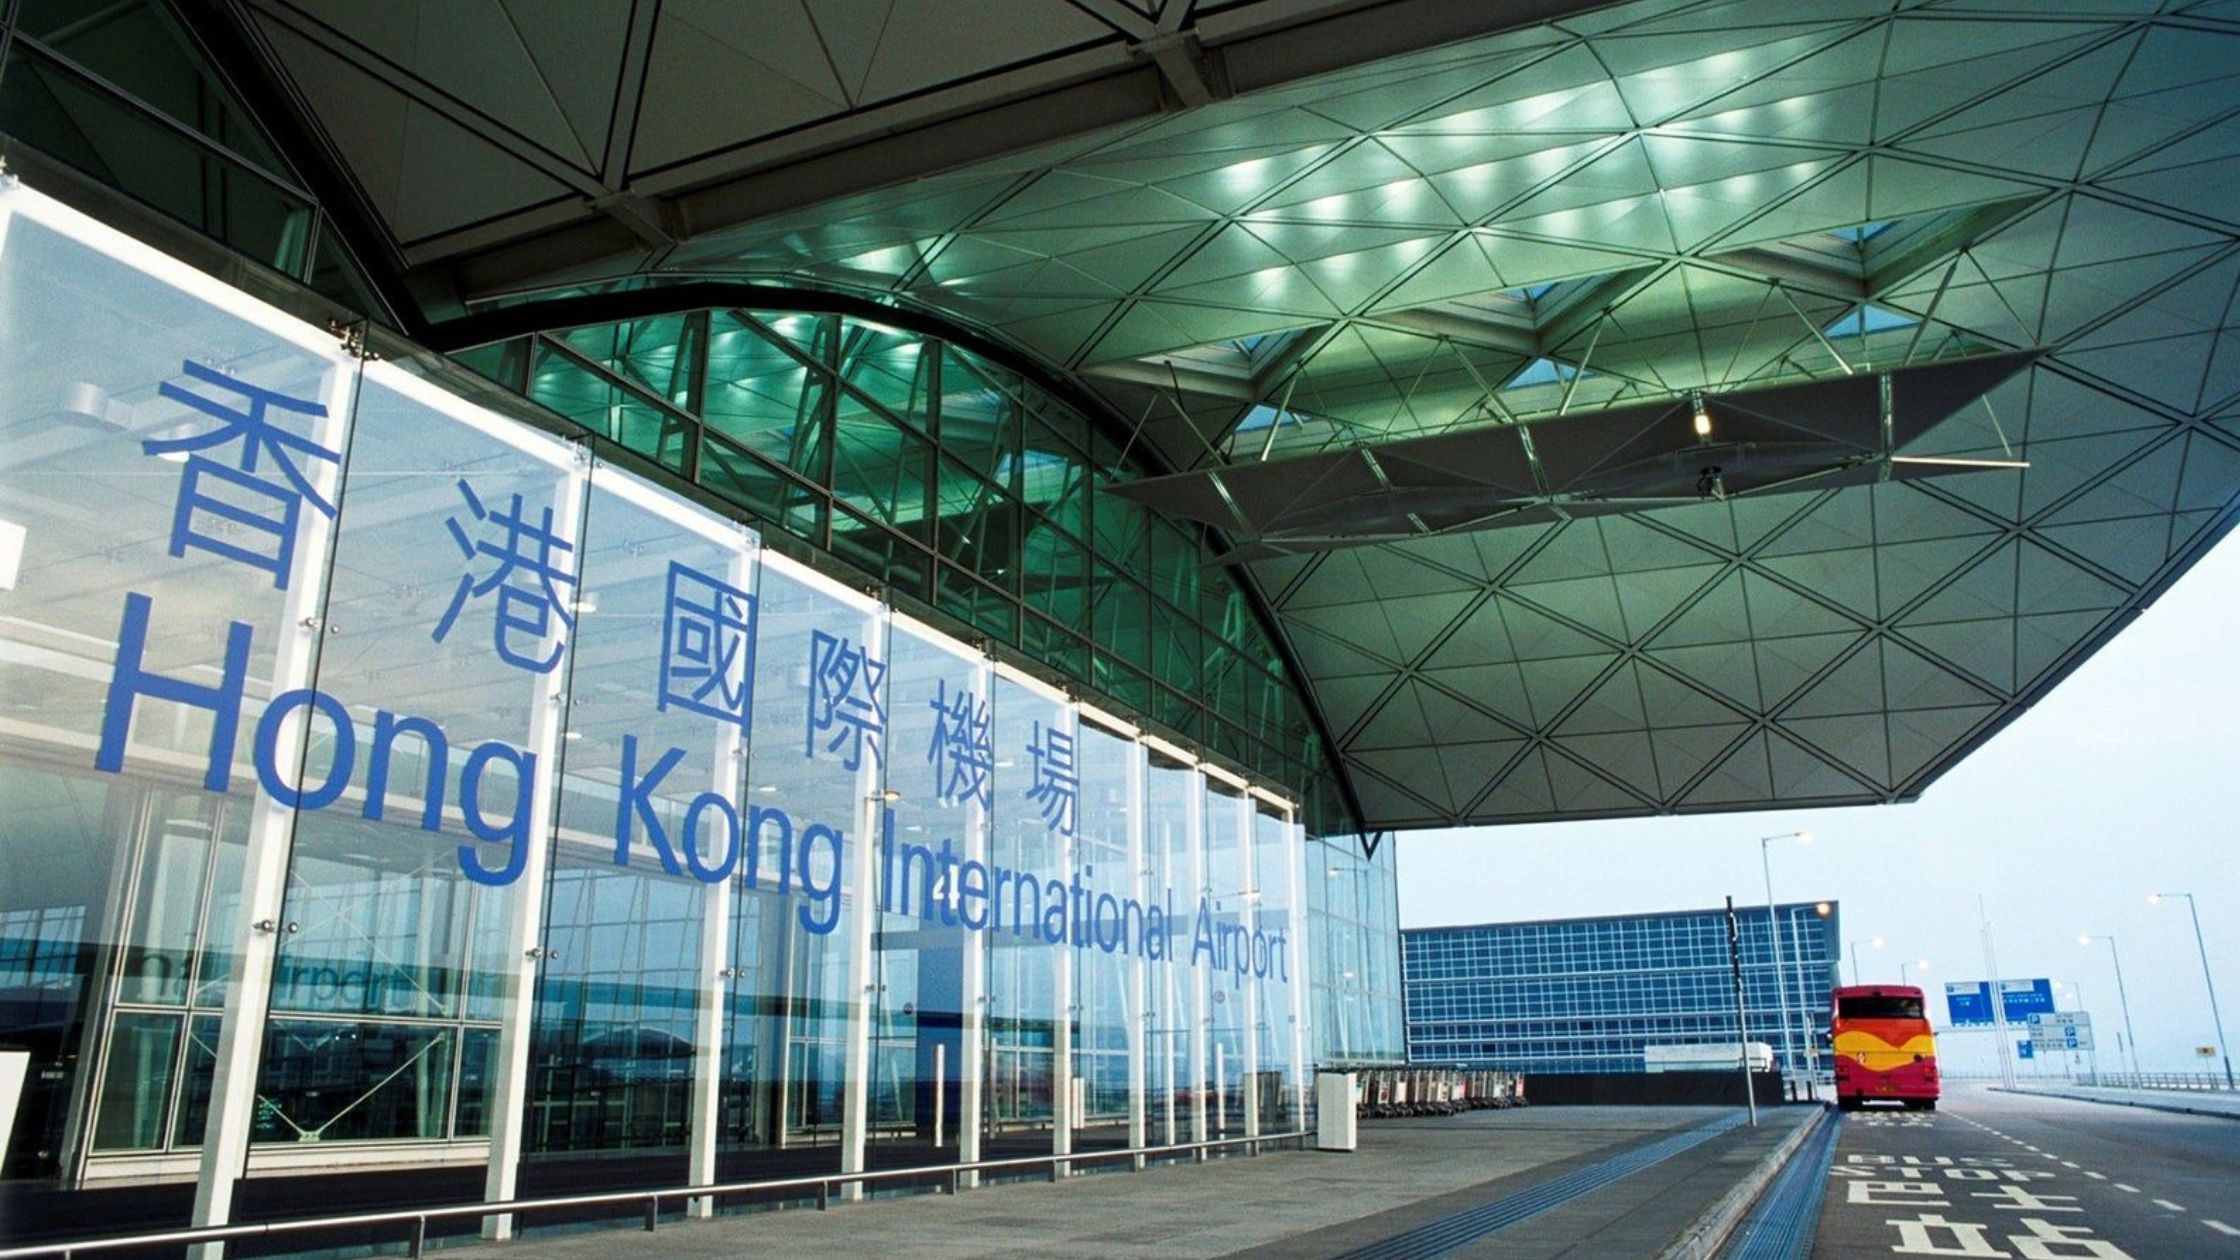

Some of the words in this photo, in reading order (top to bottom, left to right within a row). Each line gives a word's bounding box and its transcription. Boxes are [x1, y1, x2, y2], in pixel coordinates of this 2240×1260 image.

[142, 359, 1080, 837] 香港國際機場
[94, 591, 537, 887] Hong
[613, 734, 844, 935] Kong
[882, 807, 1173, 963] International
[1191, 896, 1288, 990] Airport
[1828, 1165, 2056, 1182] STOP
[1847, 1154, 2014, 1168] BUS
[1846, 1180, 2085, 1213] 巴士
[1885, 1213, 2138, 1260] 站
